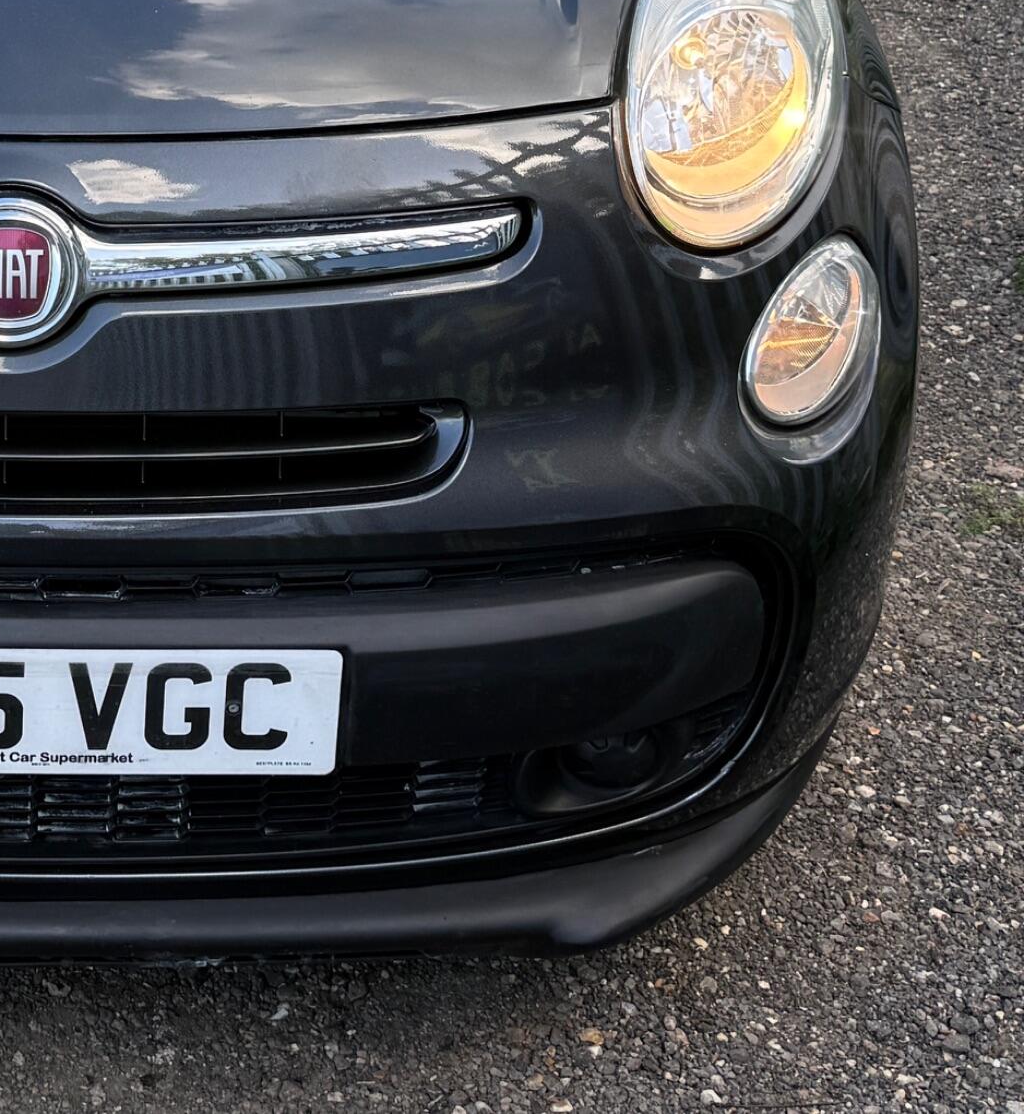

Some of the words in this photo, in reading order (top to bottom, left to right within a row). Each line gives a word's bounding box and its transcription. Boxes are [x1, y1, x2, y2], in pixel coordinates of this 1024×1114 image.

[68, 662, 292, 751] VGC
[9, 751, 37, 763] Car
[40, 752, 134, 766] Supermarket
